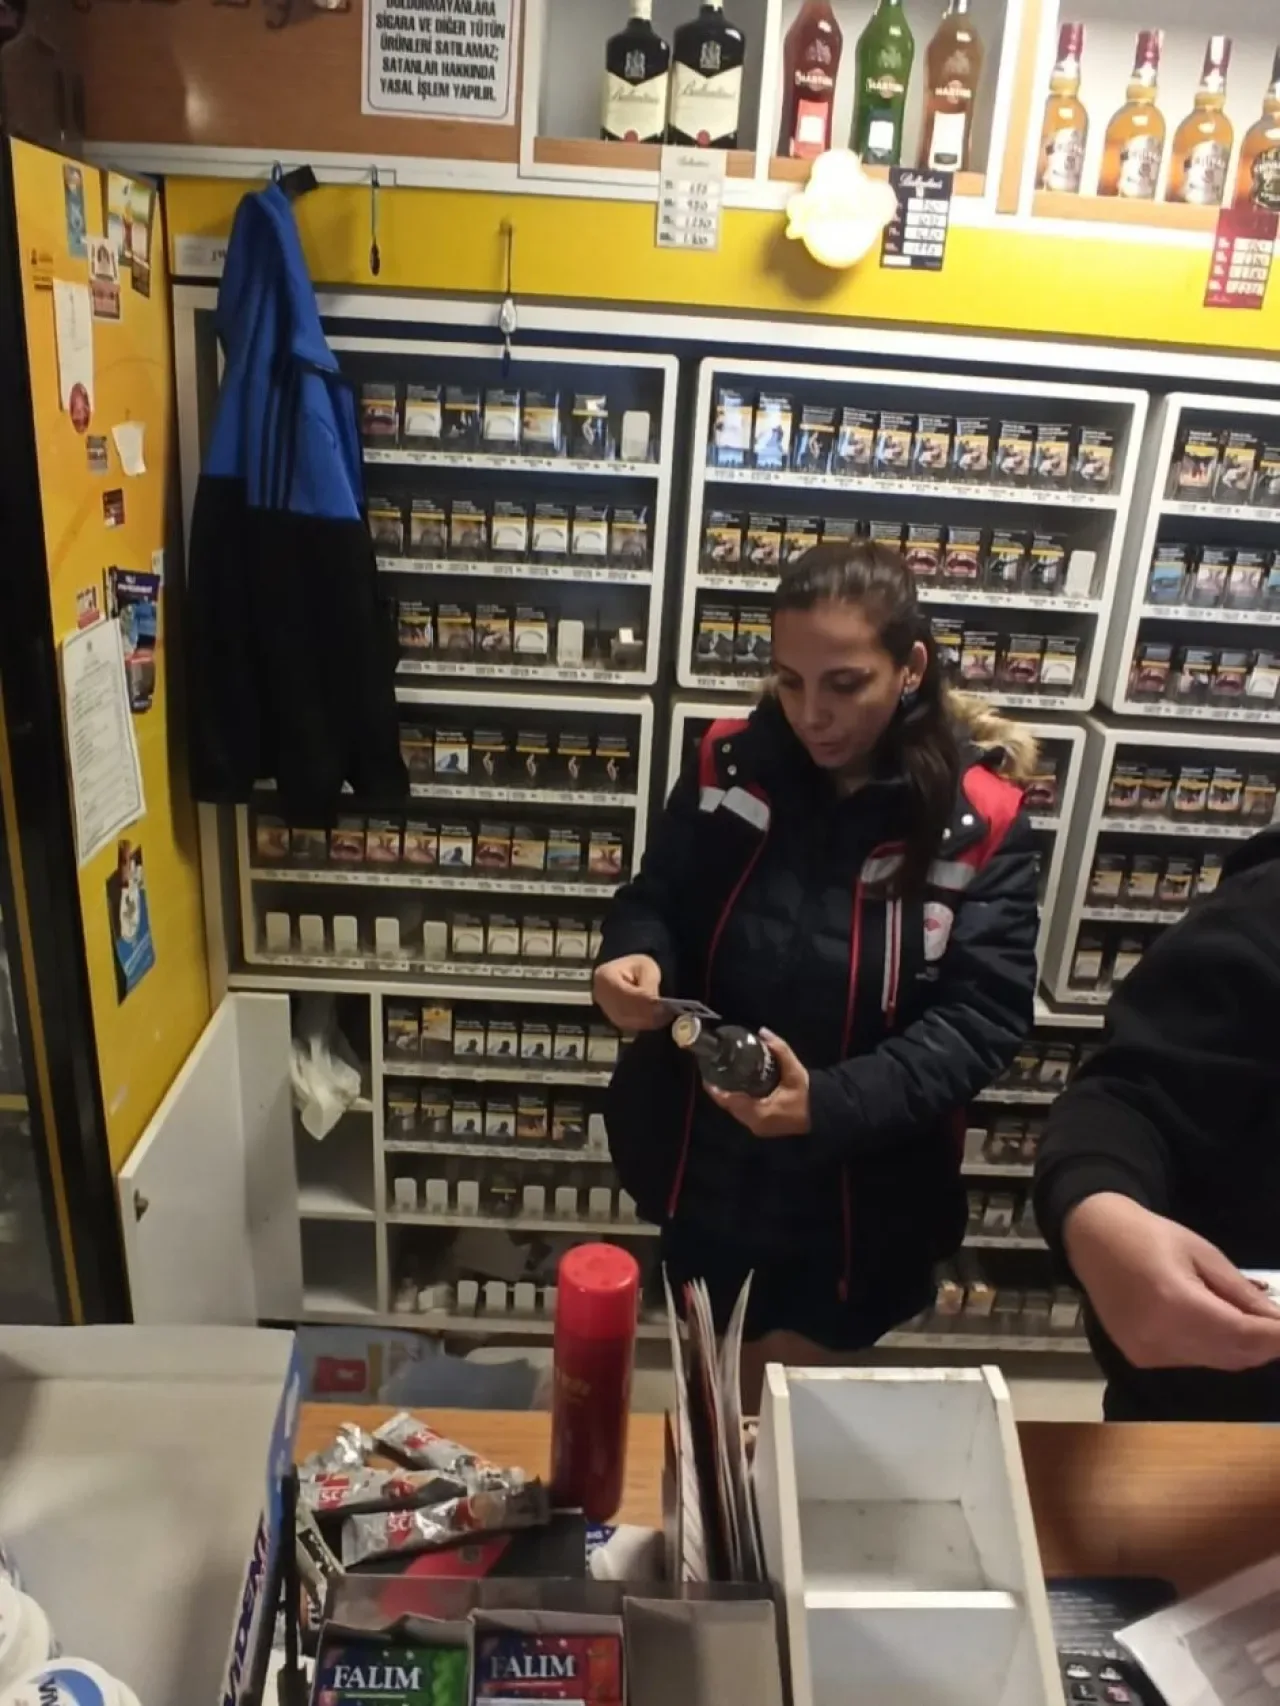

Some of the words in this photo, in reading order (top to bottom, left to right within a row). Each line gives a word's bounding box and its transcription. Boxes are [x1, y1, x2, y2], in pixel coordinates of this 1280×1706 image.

[376, 10, 415, 31] SİGARA
[418, 16, 432, 33] VE
[435, 16, 466, 36] DİĞER
[470, 19, 506, 40] TÜTÜN
[380, 32, 432, 54] ÜRÜNLERİ
[382, 57, 438, 76] SATANLAR
[441, 62, 496, 80] HAKKINDA
[380, 78, 414, 96] YASAL
[417, 77, 449, 101] İŞLEM
[453, 84, 497, 101] YAPILIR.
[333, 1664, 423, 1690] FALIM
[490, 1653, 577, 1679] FALIM
